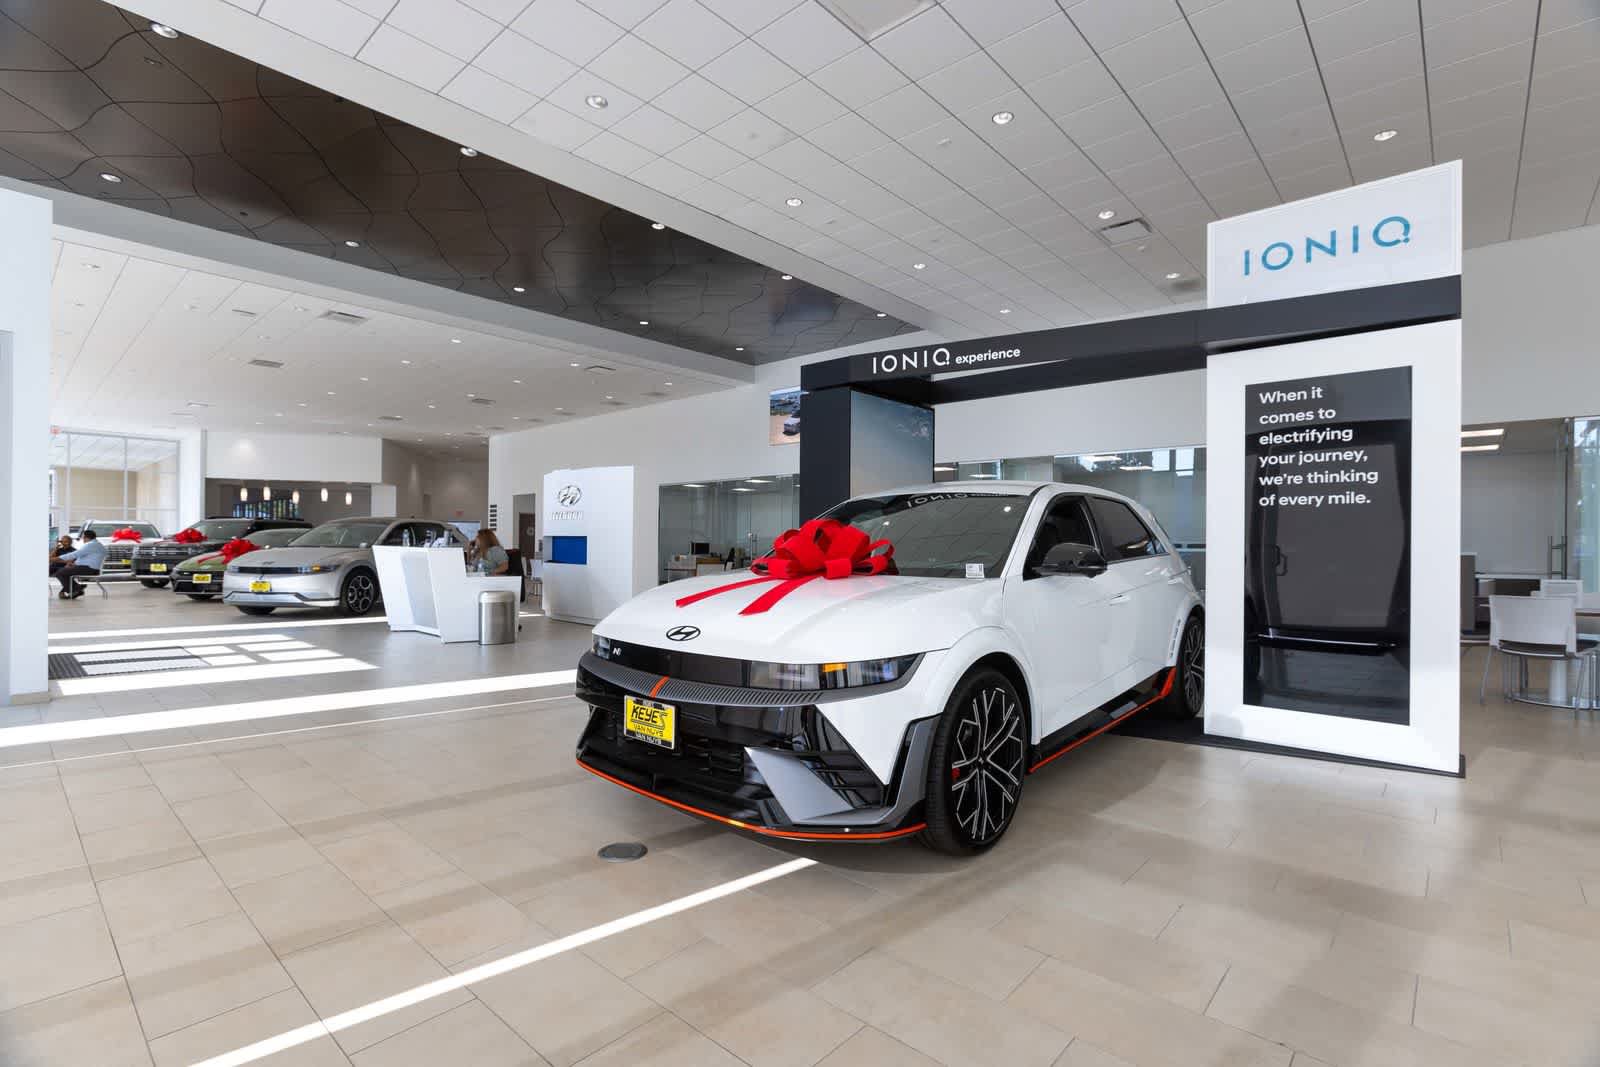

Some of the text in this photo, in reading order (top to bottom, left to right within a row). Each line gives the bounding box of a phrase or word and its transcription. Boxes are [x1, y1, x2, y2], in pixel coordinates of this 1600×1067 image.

[1243, 215, 1411, 276] IONIQ
[872, 347, 1021, 374] IONIQ experience
[1259, 386, 1323, 404] When it
[1259, 407, 1336, 425] comes to
[1259, 427, 1353, 445] electrifying
[1259, 449, 1369, 467] your journey,
[1259, 469, 1379, 486] we're thinking
[1259, 491, 1371, 508] of every mile.
